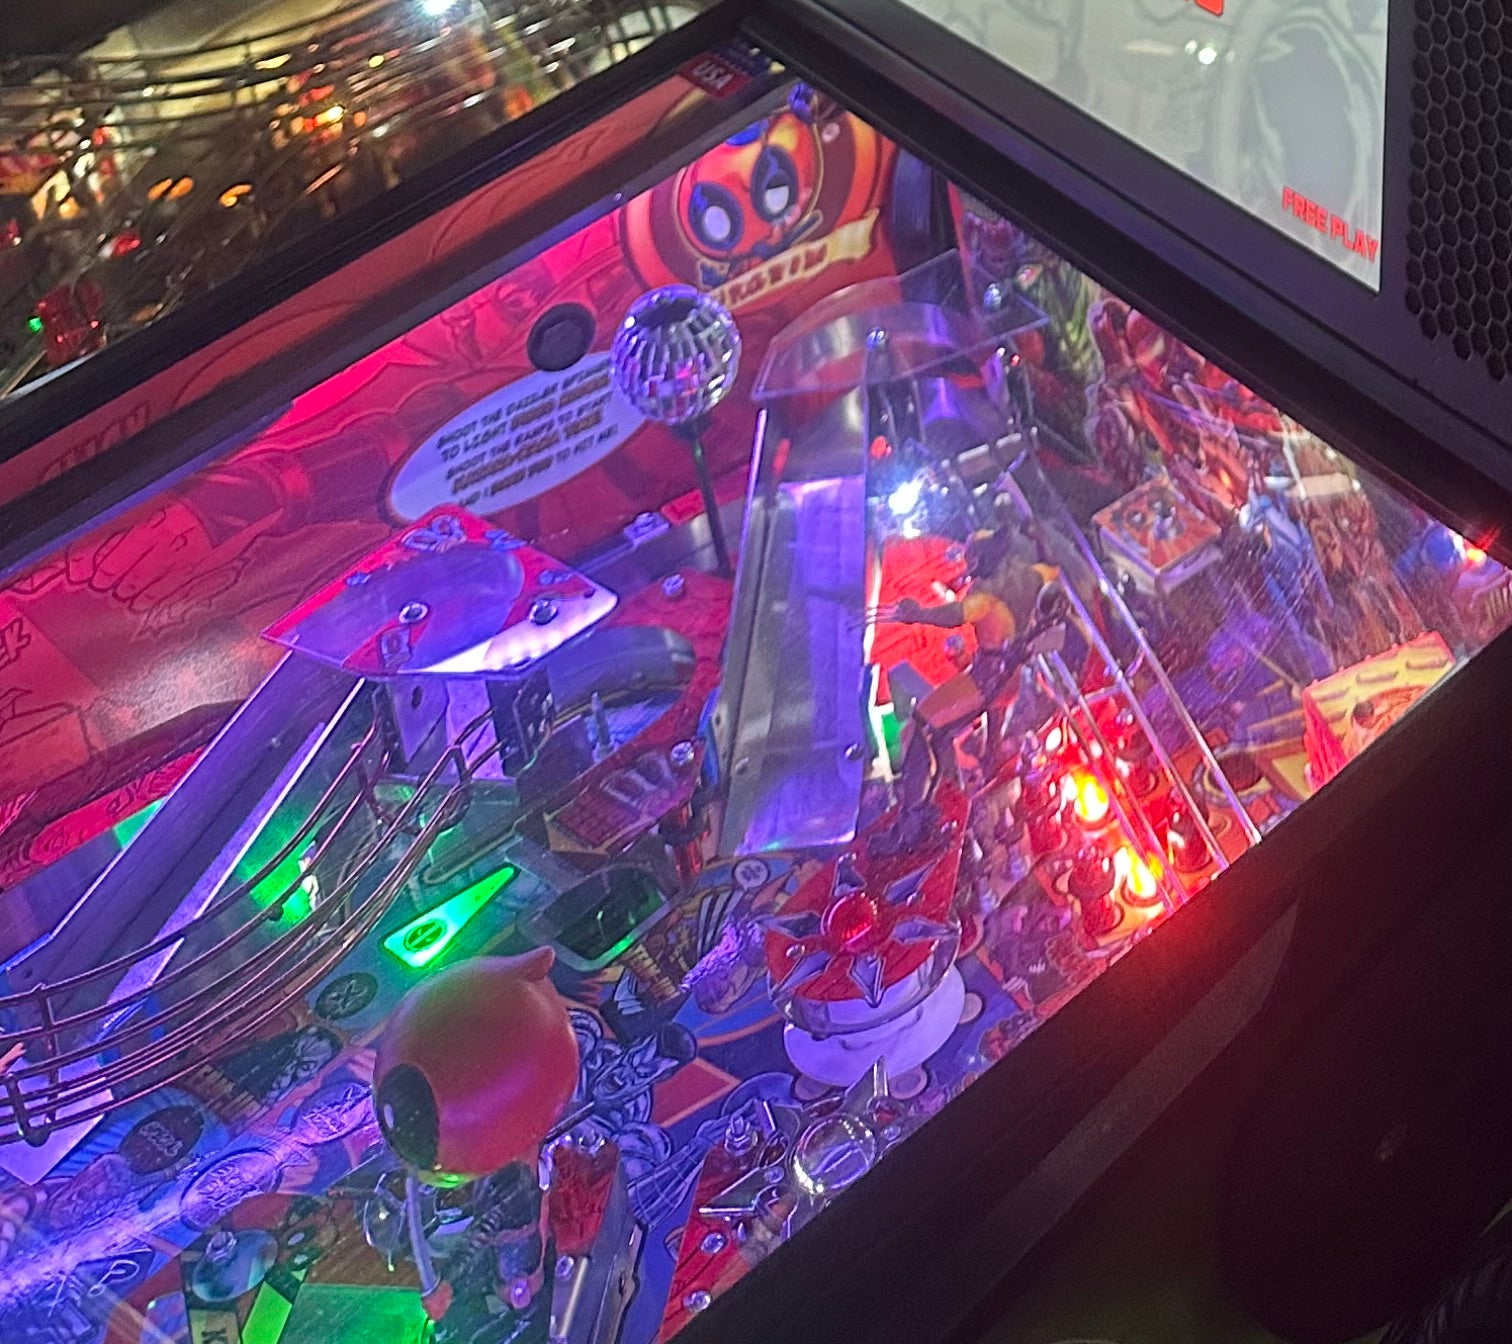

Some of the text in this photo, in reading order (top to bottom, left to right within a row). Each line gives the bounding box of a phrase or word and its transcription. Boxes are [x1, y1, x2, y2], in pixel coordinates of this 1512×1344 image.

[690, 60, 736, 92] USA
[1281, 186, 1380, 265] FREE PLAY
[441, 443, 462, 462] TO
